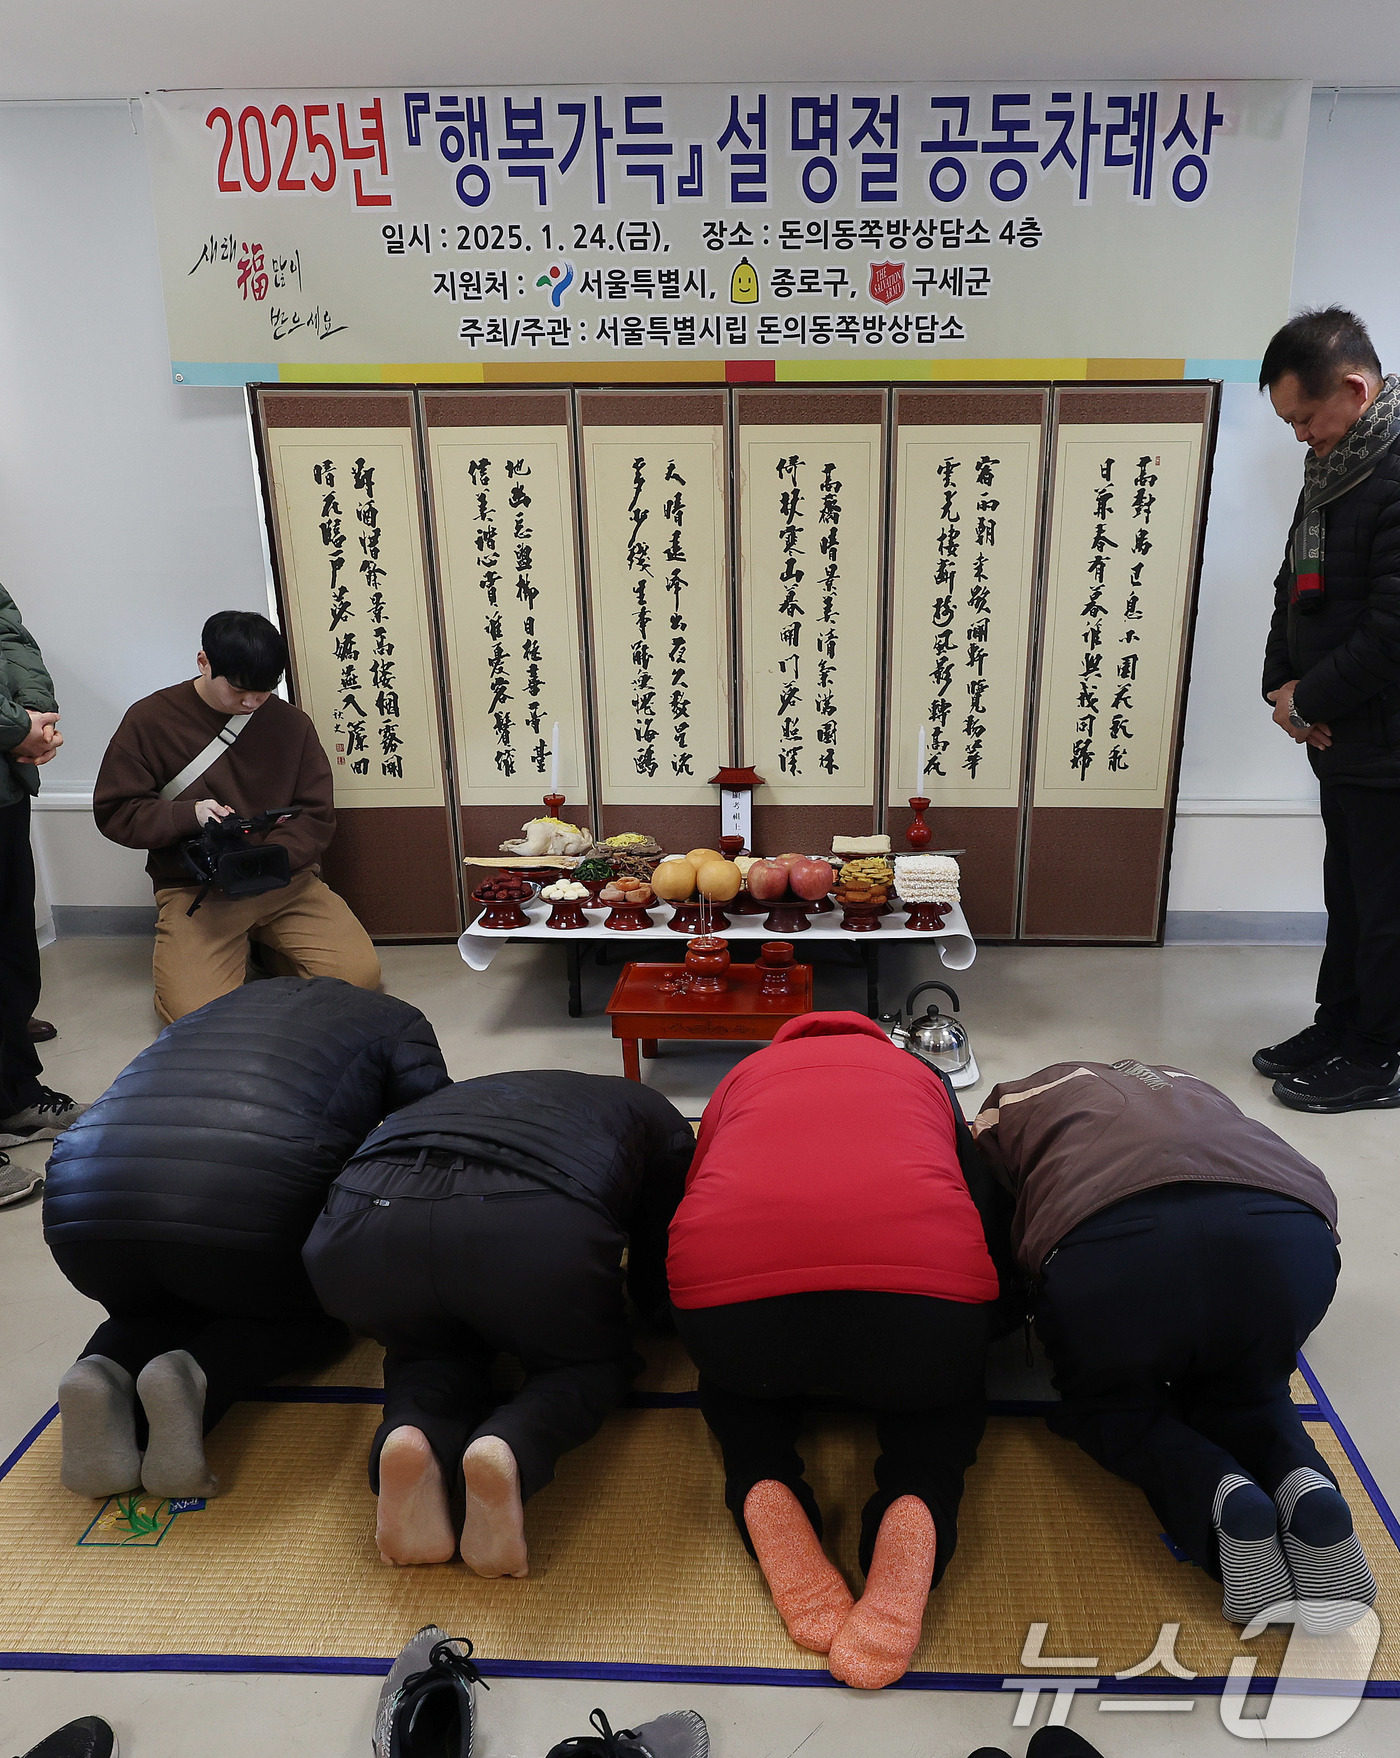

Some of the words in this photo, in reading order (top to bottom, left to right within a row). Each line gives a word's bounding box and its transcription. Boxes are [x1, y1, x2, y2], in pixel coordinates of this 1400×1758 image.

[205, 97, 392, 207] 2025년
[716, 94, 767, 203] 설
[791, 94, 899, 204] 명절
[920, 91, 1224, 203] 공동차례상
[381, 223, 431, 254] 일시
[456, 224, 532, 252] 2025.
[541, 224, 564, 252] 1.
[702, 220, 754, 250] 장소
[778, 218, 991, 250] 돈의동쪽방상담소
[998, 216, 1043, 248] 4층
[433, 270, 508, 301] 지원처
[579, 268, 716, 300] 서울특별시,
[770, 268, 857, 299] 종로구,
[911, 266, 991, 297] 구세군
[876, 267, 887, 282] THE
[270, 306, 349, 340] 받으세요
[460, 316, 572, 347] 주최/주관
[595, 315, 747, 346] 서울특별시립
[756, 314, 965, 345] 돈의동쪽방상담소
